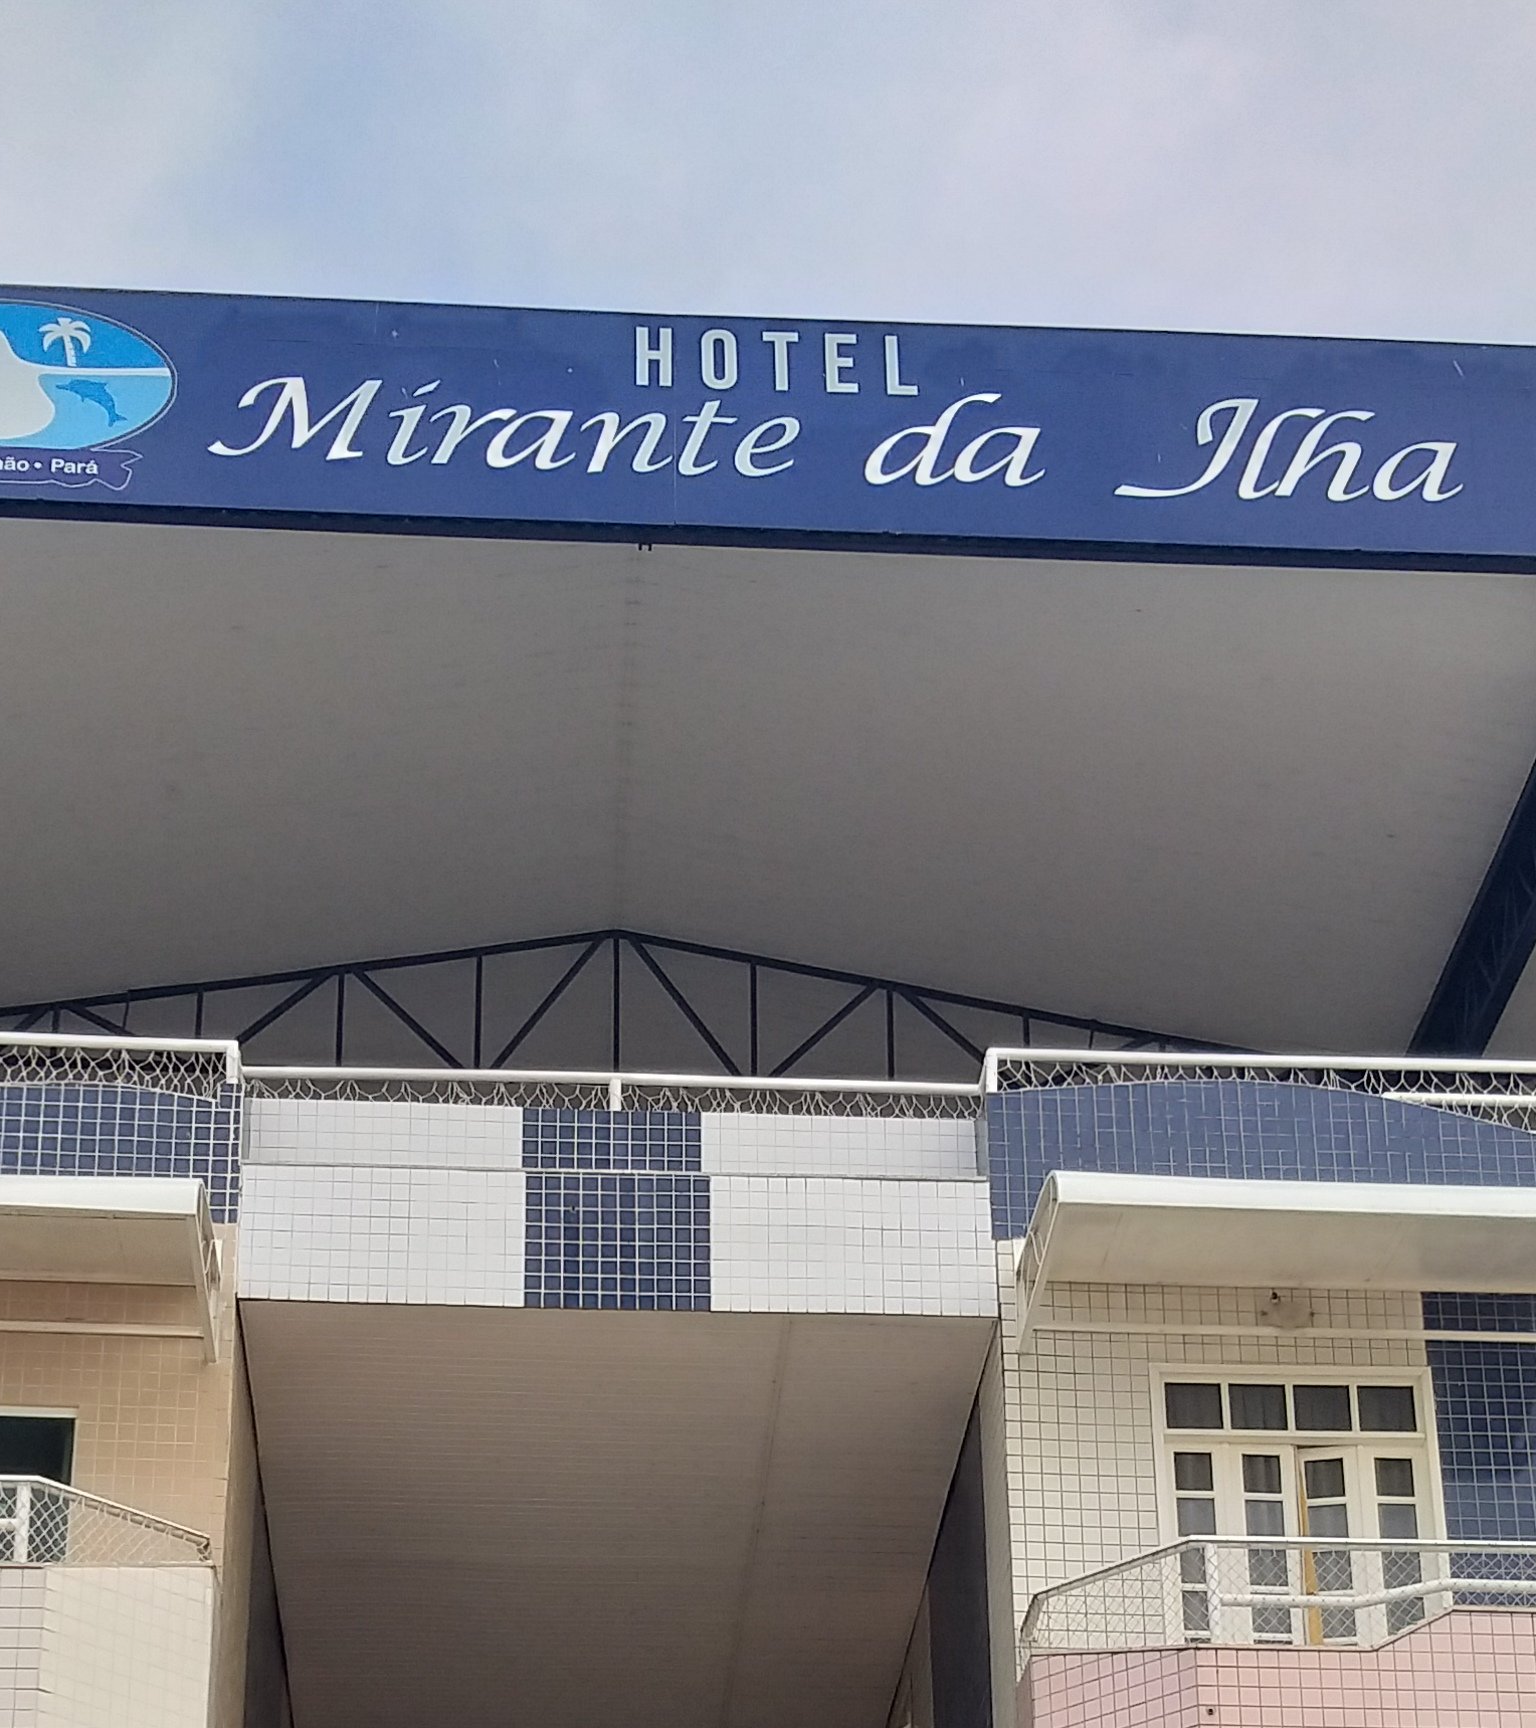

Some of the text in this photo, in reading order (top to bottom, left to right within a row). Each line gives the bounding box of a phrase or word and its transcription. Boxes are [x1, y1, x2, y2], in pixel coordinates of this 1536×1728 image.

[634, 325, 919, 397] HOTEL
[50, 457, 99, 475] Pará
[207, 375, 1465, 502] Mirante da Ilha
